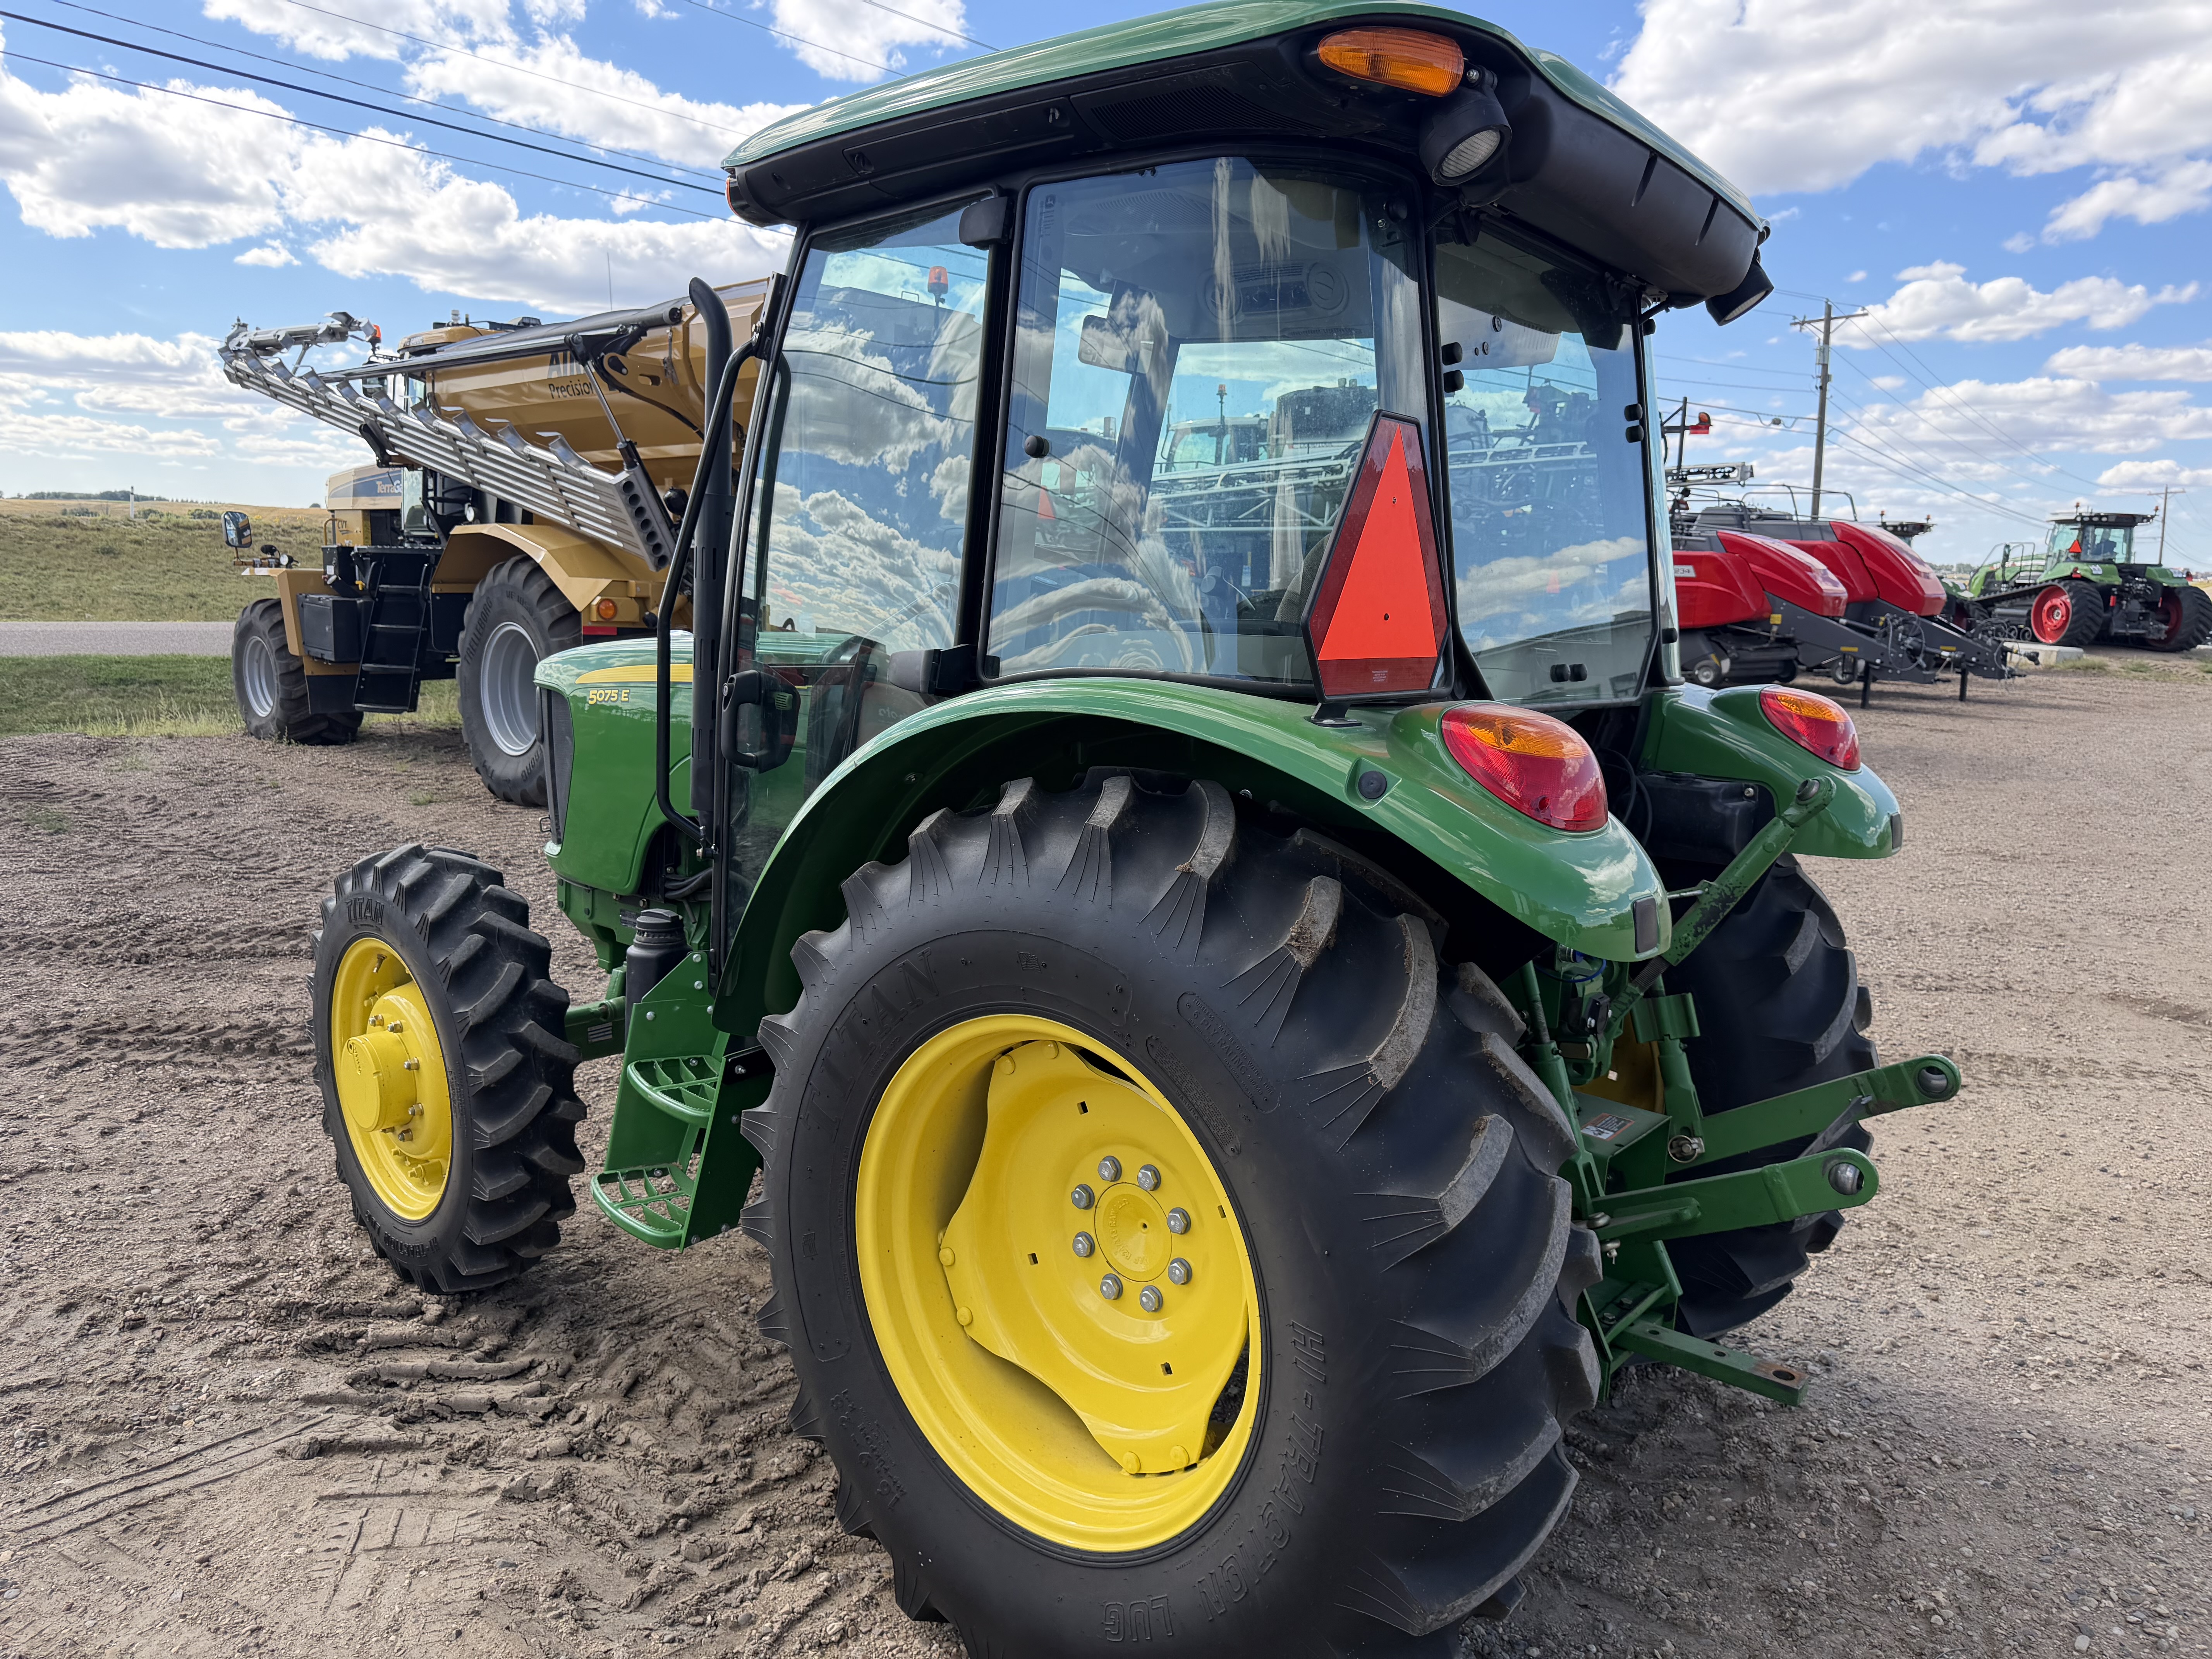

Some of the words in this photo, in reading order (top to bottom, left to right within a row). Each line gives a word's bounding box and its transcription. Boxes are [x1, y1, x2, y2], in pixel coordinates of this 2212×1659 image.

[337, 520, 347, 529] CVT
[465, 596, 493, 665] TRELLEBORG
[589, 690, 618, 705] 5075
[621, 689, 630, 701] E
[346, 897, 385, 925] TITAN
[798, 947, 939, 1143] TITAN
[1193, 1010, 1201, 1019] 6
[1200, 1017, 1219, 1037] PLY
[1216, 1036, 1248, 1075] RATING
[1218, 1025, 1230, 1037] MAY
[364, 1209, 381, 1235] LUG
[1104, 1594, 1173, 1642] LUG
